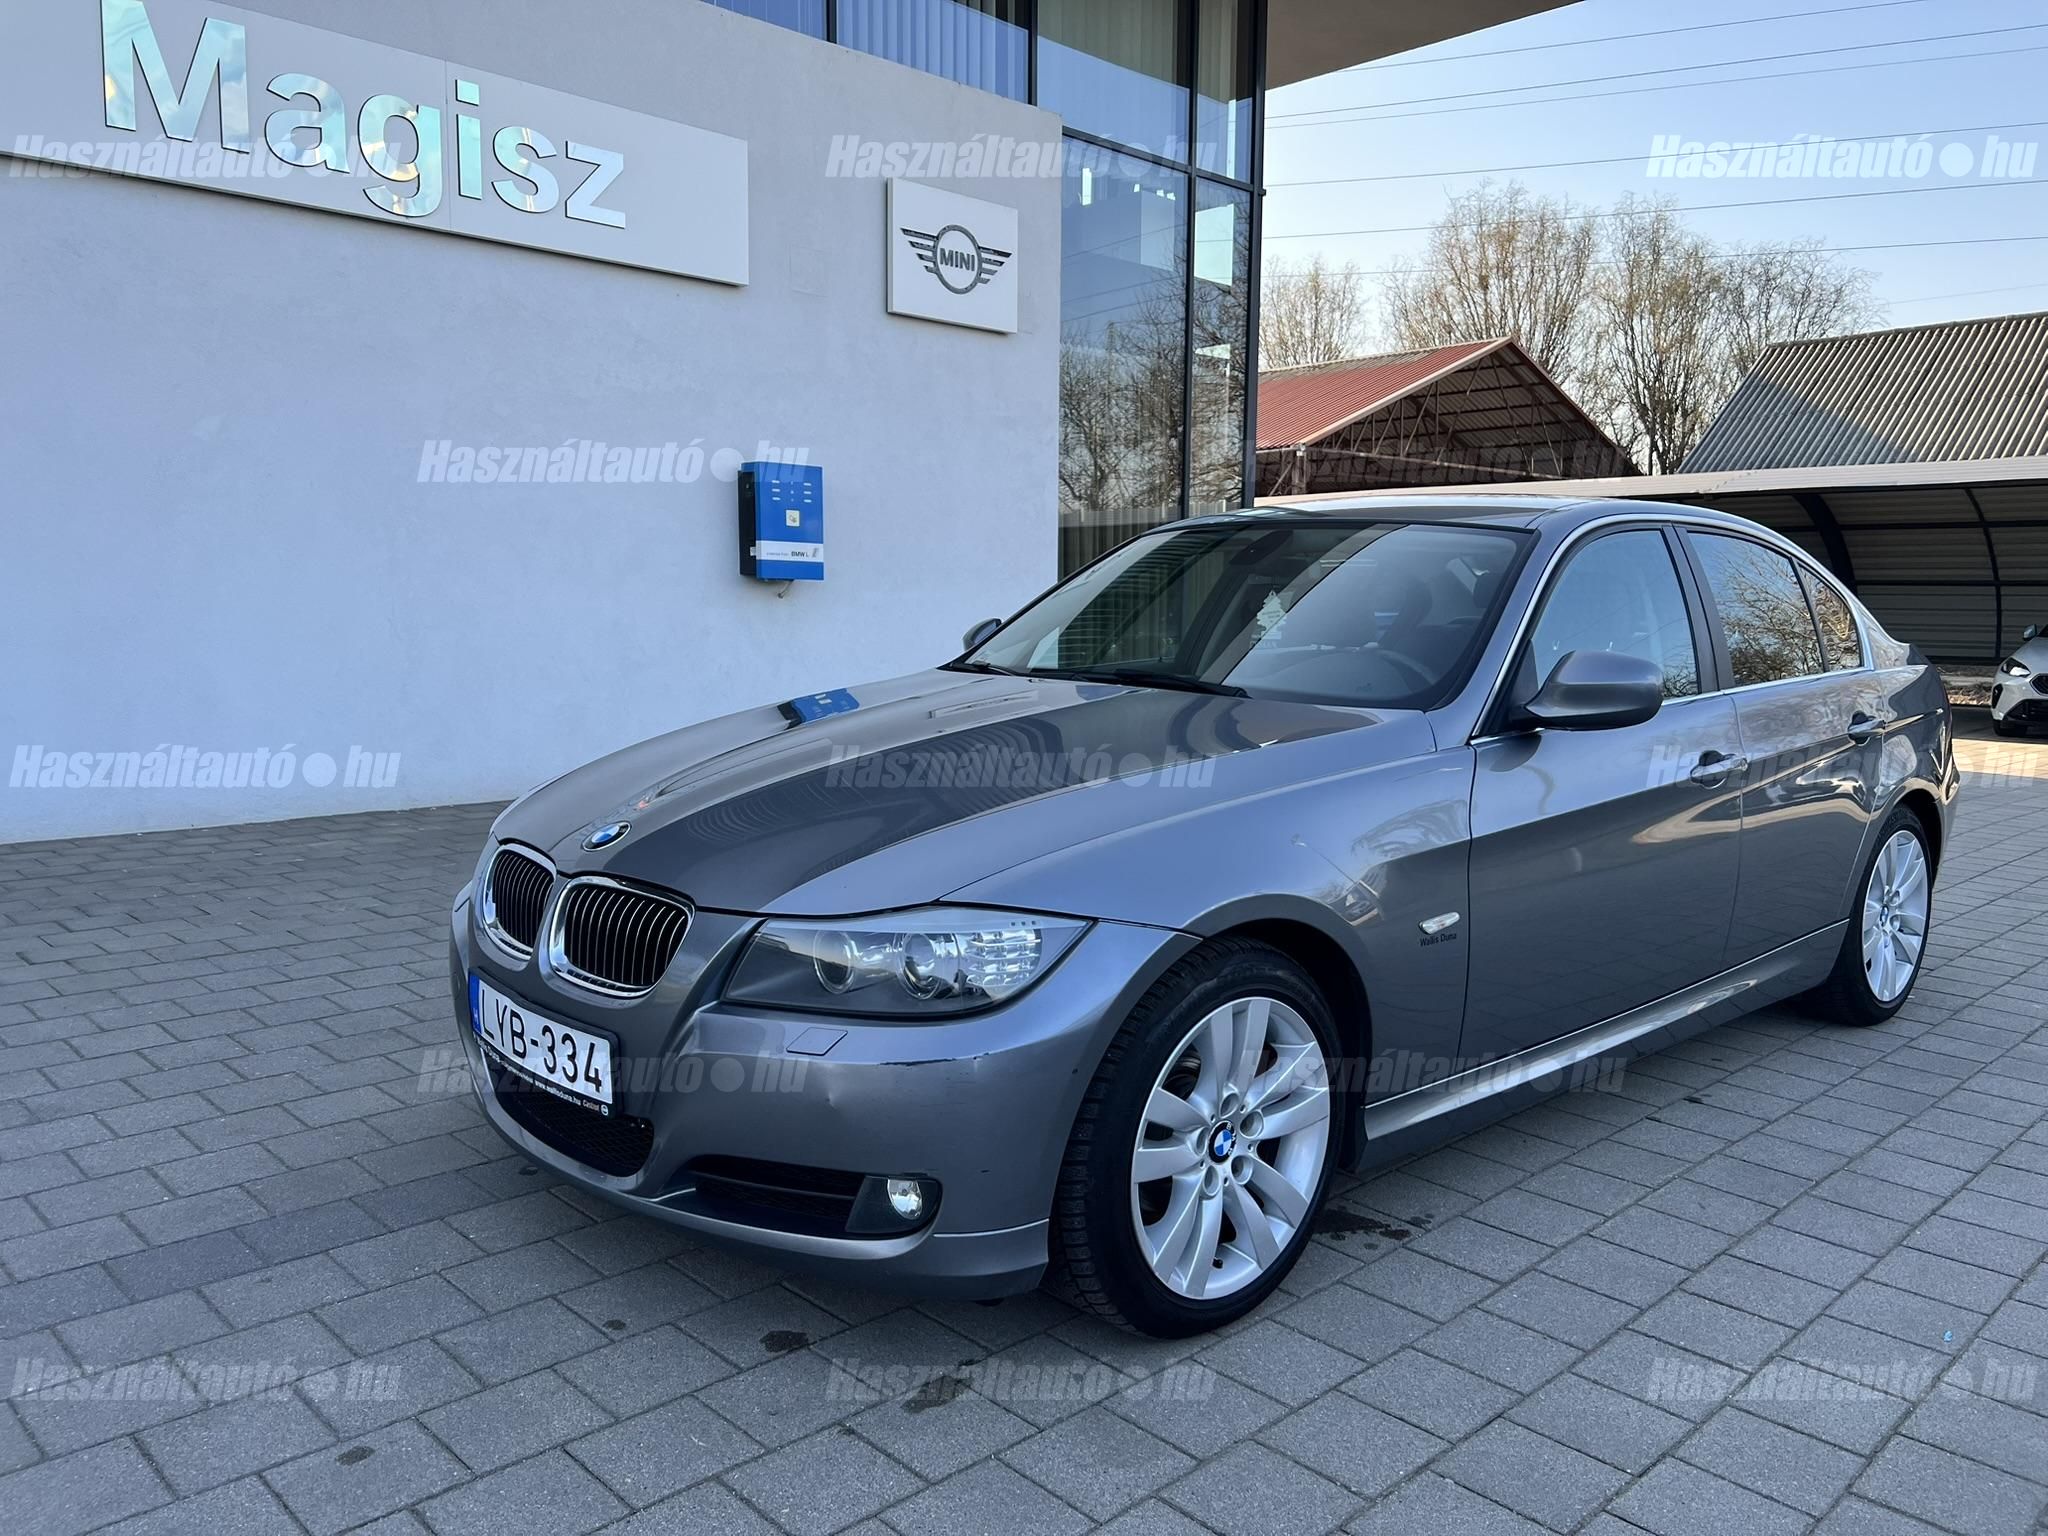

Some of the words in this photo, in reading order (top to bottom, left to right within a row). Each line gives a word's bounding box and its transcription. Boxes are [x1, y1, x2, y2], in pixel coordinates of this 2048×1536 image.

[100, 0, 626, 229] Magisz
[940, 248, 975, 271] MINI
[1420, 936, 1439, 947] Wallis
[1440, 933, 1457, 943] Duna
[481, 989, 602, 1093] LYB-334
